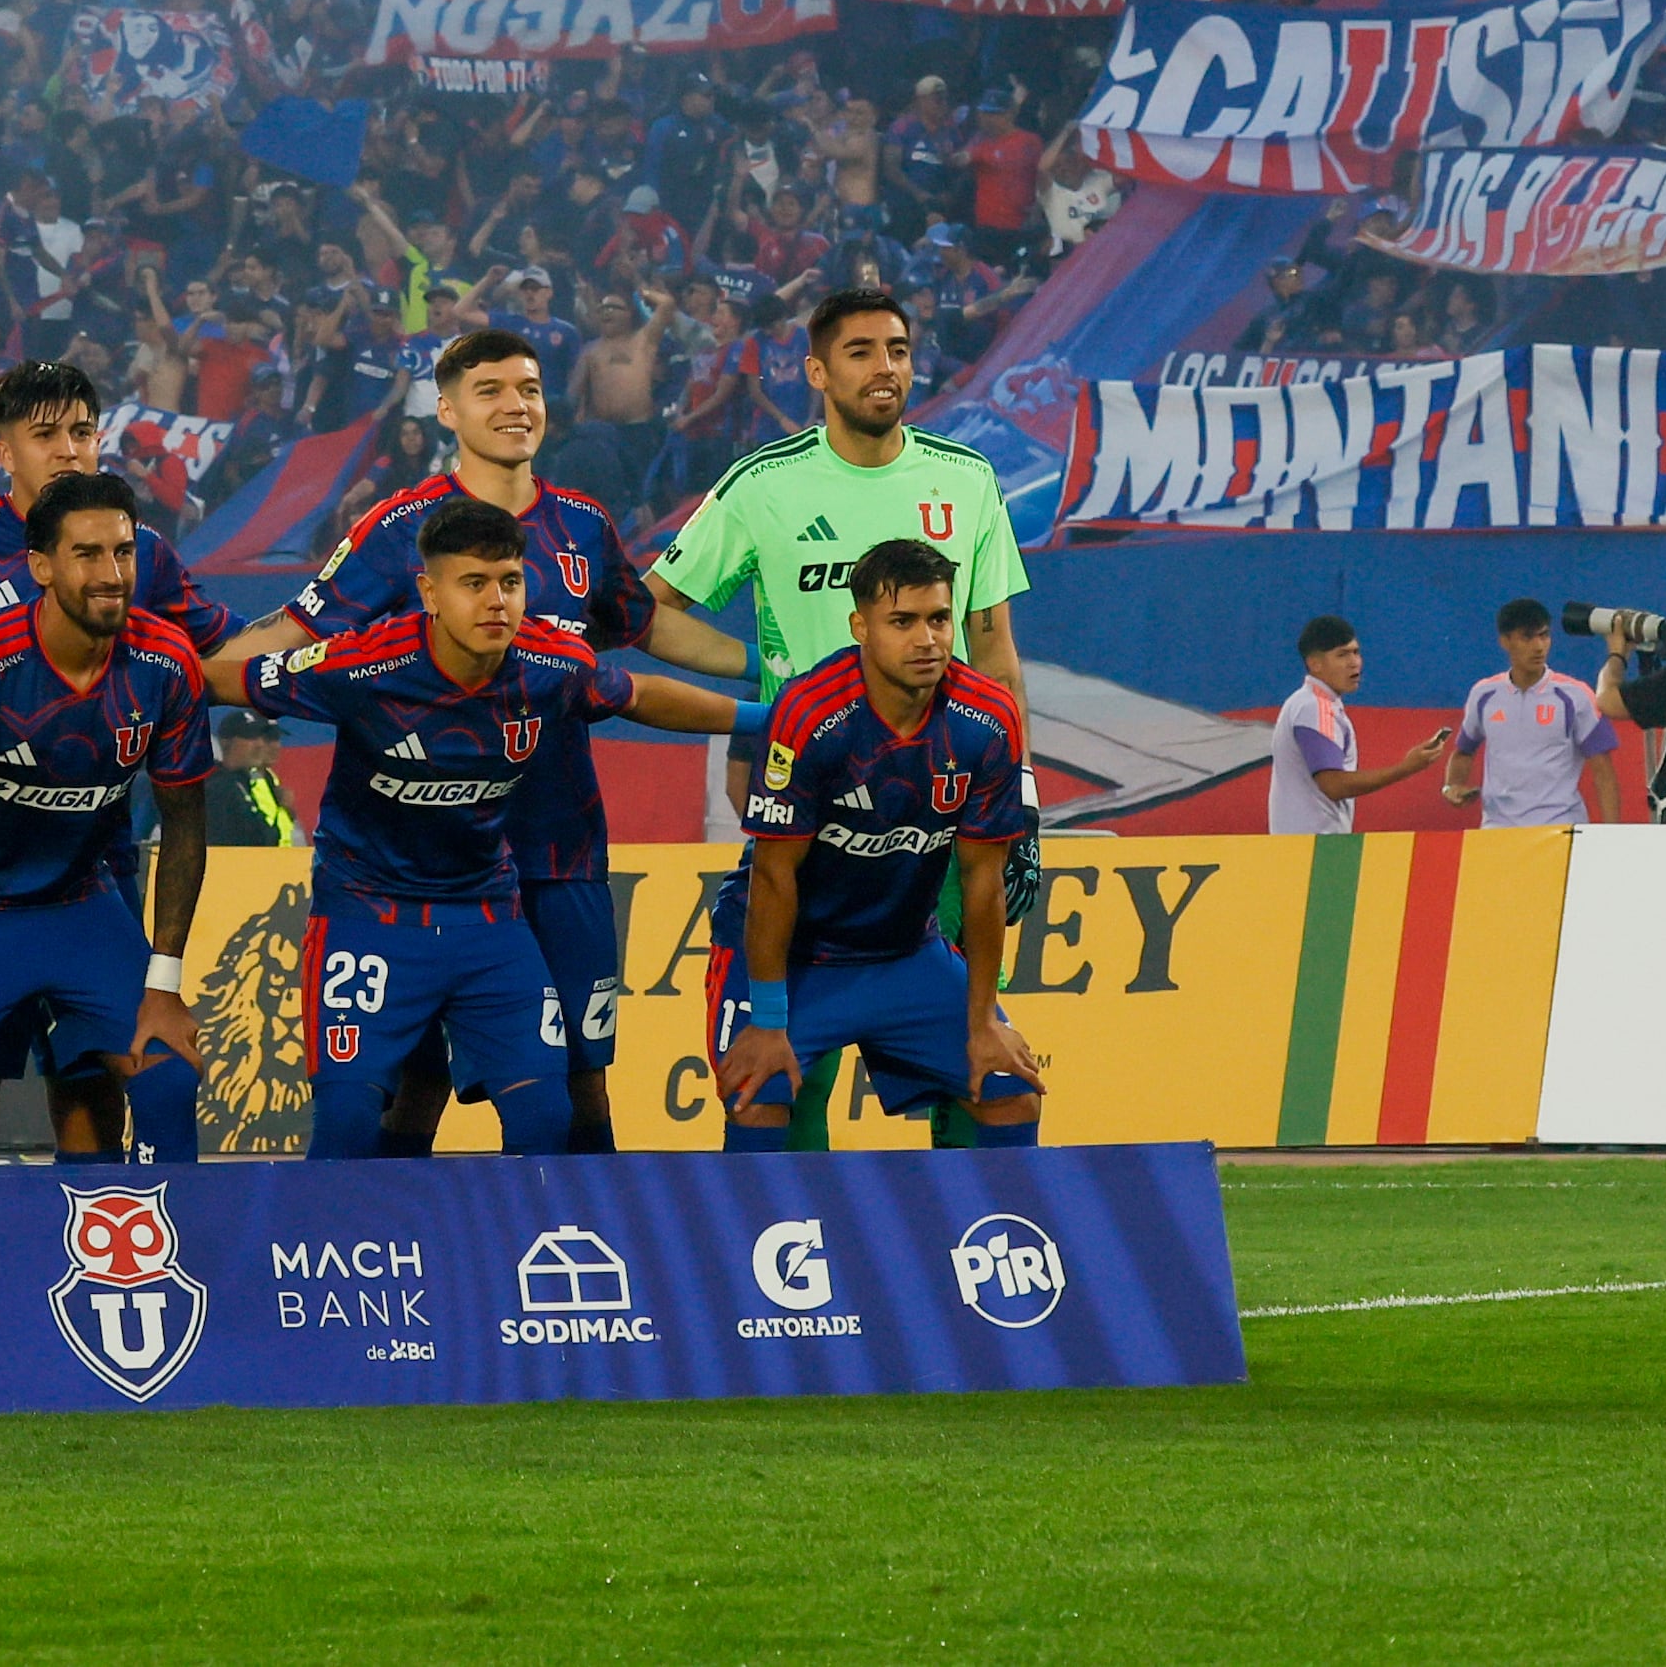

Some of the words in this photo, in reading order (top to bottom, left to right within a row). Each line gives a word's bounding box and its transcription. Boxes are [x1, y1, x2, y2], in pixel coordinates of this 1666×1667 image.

[751, 449, 818, 478] MACHBANK
[921, 447, 991, 475] MACHBANK
[917, 501, 956, 542] U
[555, 550, 591, 600] U
[129, 645, 184, 678] MACHBAN
[348, 651, 419, 682] MACHBANK
[516, 648, 580, 676] MACHBANK
[946, 697, 1009, 740] MACHBANK
[115, 721, 153, 768] U
[503, 717, 542, 765] U
[931, 772, 972, 814] U
[323, 950, 389, 1014] 23
[326, 1024, 360, 1063] U
[271, 1239, 424, 1281] MACH
[277, 1289, 432, 1330] BANK
[736, 1314, 863, 1339] GATORADE
[89, 1292, 168, 1370] U
[499, 1316, 655, 1346] SODIMAC
[366, 1344, 385, 1361] de
